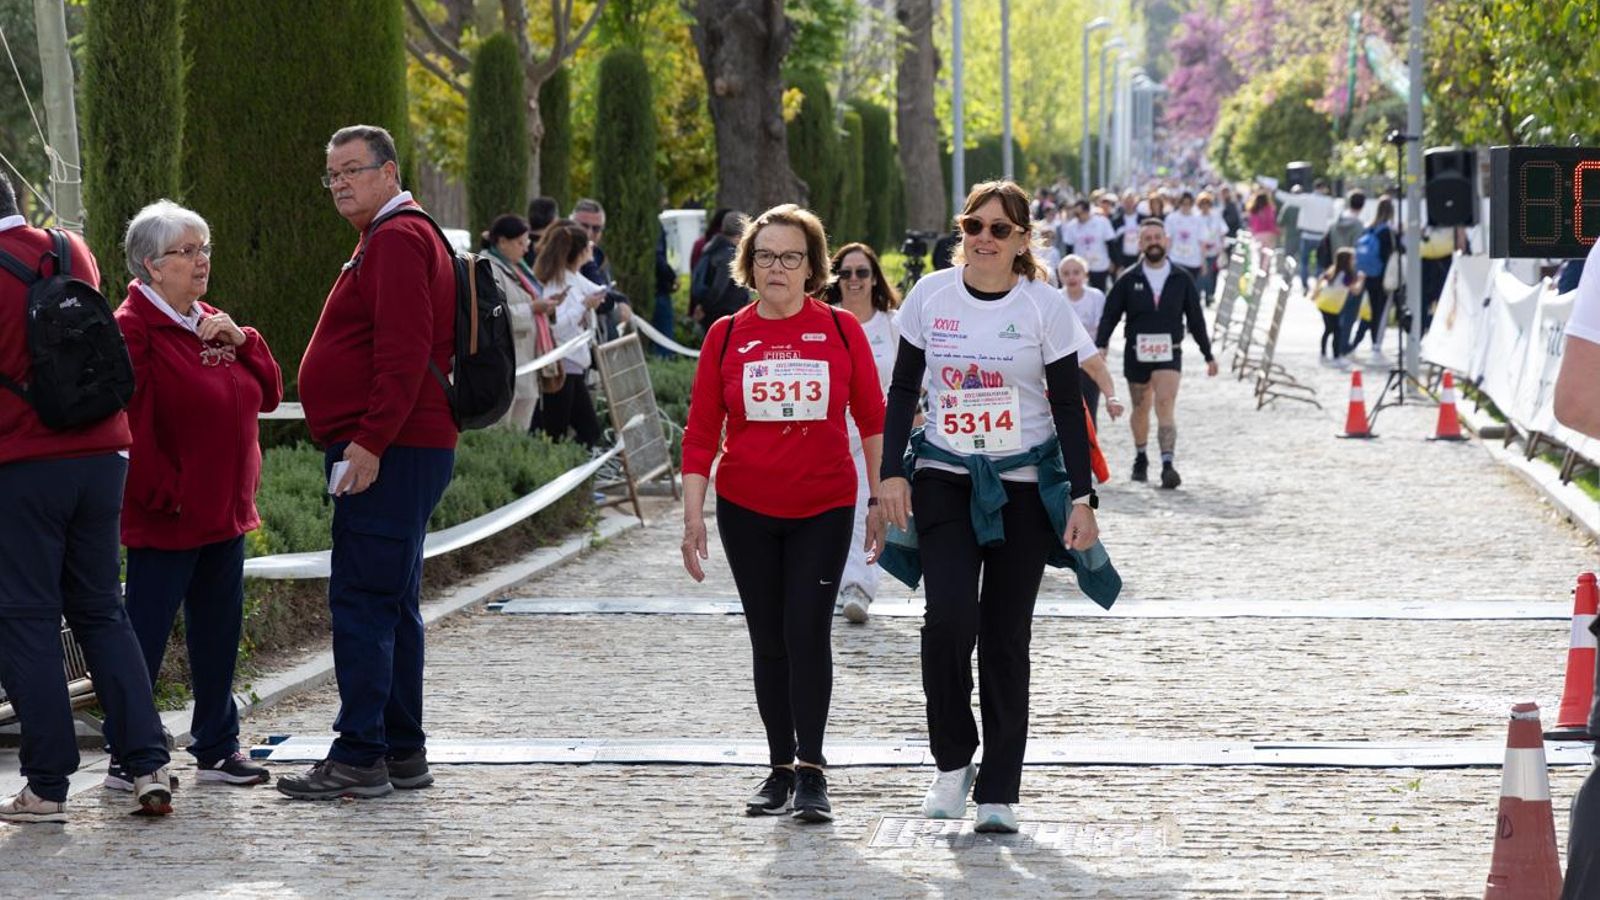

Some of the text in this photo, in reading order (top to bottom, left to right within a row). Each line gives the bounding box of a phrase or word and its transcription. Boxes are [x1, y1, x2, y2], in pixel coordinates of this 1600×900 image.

[933, 318, 960, 331] XXVII
[751, 381, 823, 402] 5313
[943, 410, 1014, 435] 5314
